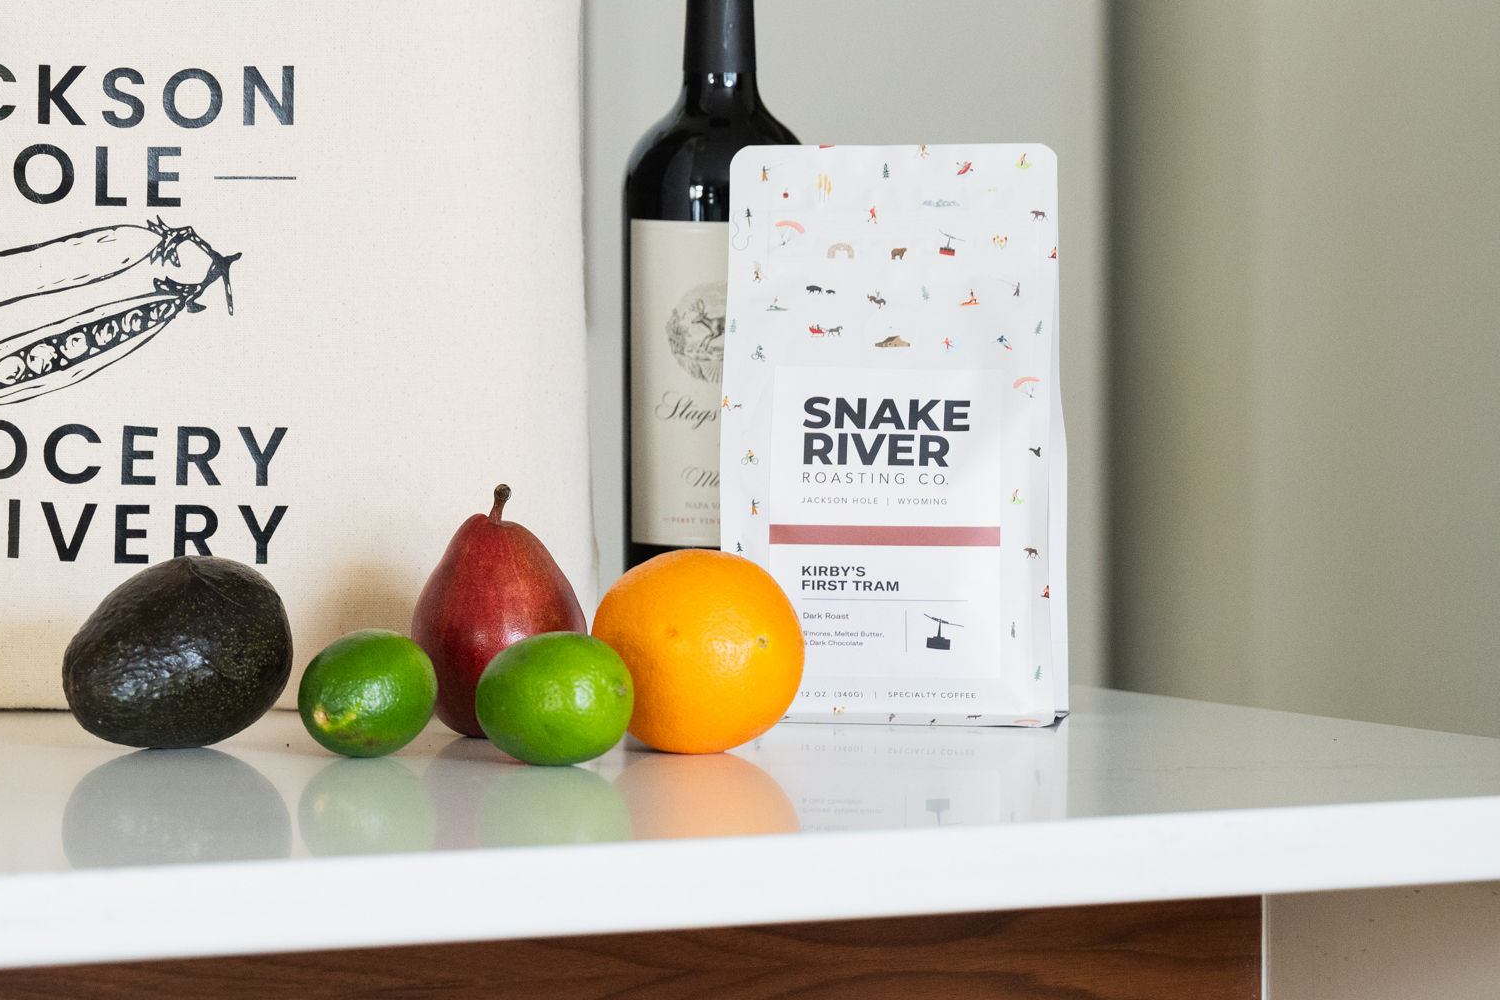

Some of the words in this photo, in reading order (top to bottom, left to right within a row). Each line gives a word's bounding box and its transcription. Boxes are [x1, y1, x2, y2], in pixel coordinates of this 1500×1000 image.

[802, 396, 971, 432] SNAKE
[803, 432, 950, 467] RIVER
[802, 472, 905, 485] ROASTING
[918, 472, 949, 485] CO.
[801, 496, 848, 505] JACKSON
[852, 496, 879, 505] HOLE
[897, 497, 947, 505] WYOMING
[801, 565, 866, 577] KIRBY'S
[801, 579, 847, 591] FIRST
[852, 580, 900, 592] TRAM
[802, 611, 822, 620] Dark
[825, 612, 850, 620] Roast
[861, 631, 885, 639] Butter,
[833, 691, 864, 699] (340G)
[888, 691, 937, 699] SPECIALTY
[940, 691, 977, 699] COFFEE
